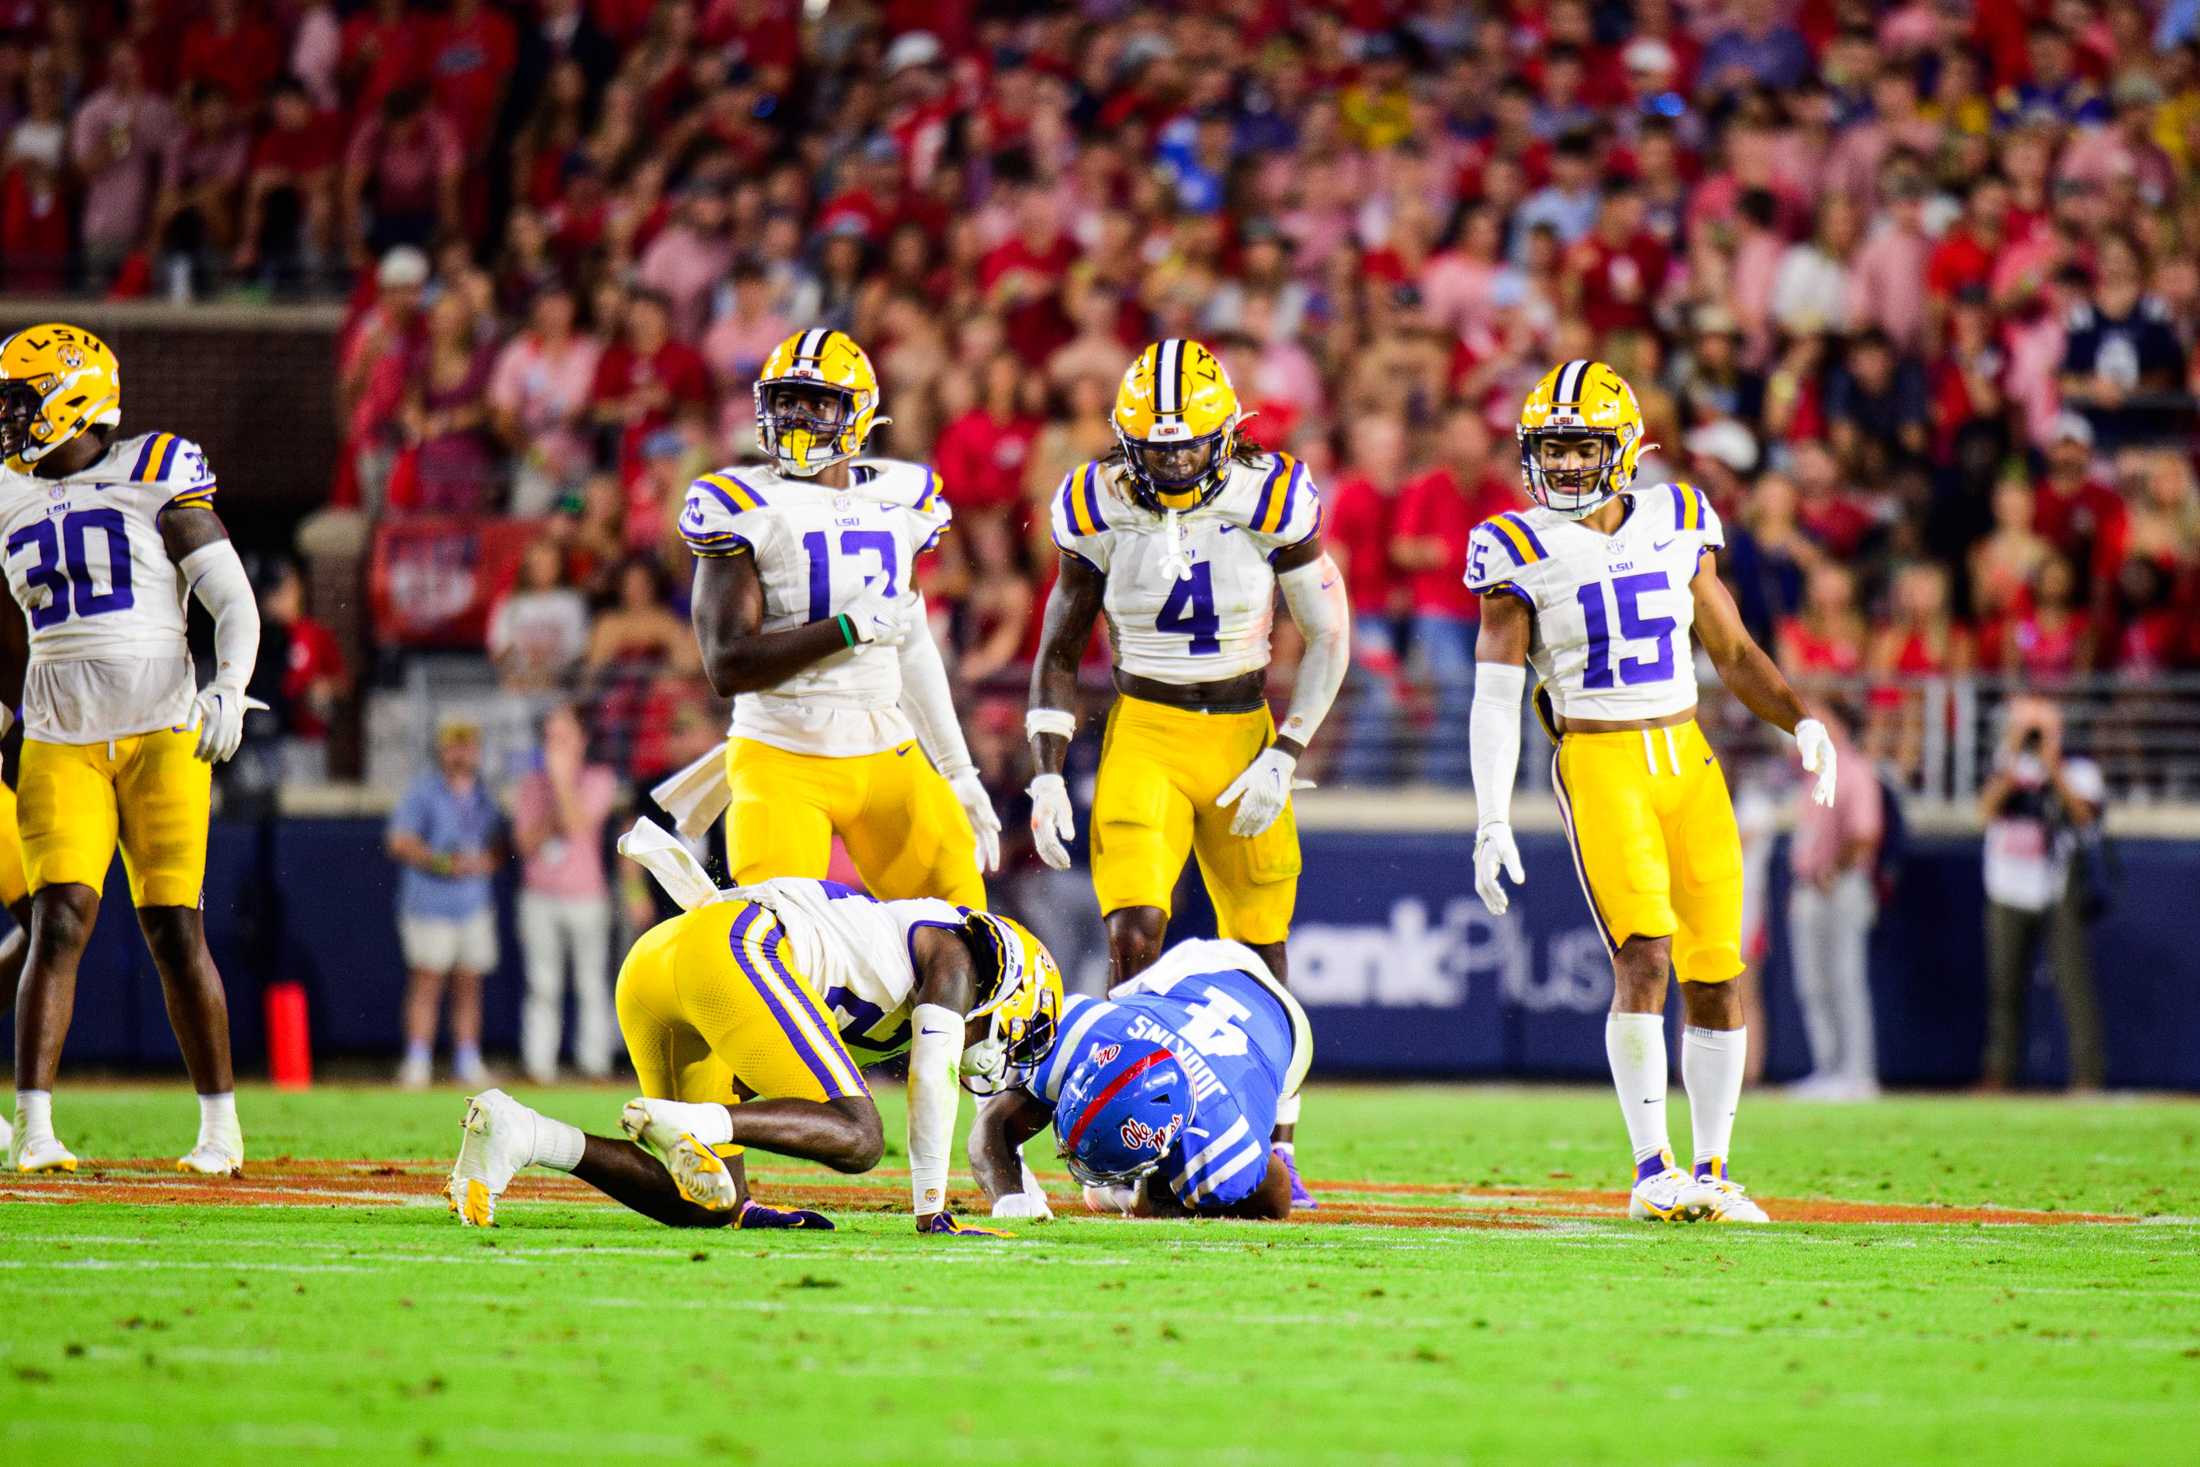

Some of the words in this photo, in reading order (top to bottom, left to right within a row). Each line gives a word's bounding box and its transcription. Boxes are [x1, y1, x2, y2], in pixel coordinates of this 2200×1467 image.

[27, 329, 100, 353] LSU
[1158, 427, 1179, 436] LSU
[1552, 416, 1574, 425] LSU
[46, 501, 71, 515] LSU
[835, 517, 860, 527] LSU
[6, 508, 135, 630] 30
[1608, 561, 1633, 573] LSU
[1156, 560, 1221, 656] 4
[1577, 571, 1677, 689] 15
[1286, 897, 1615, 1013] ankPlus
[1175, 986, 1253, 1057] 4
[1127, 1014, 1229, 1101] JUDKINS
[1121, 1117, 1153, 1150] Ole
[1146, 1114, 1183, 1153] Mss
